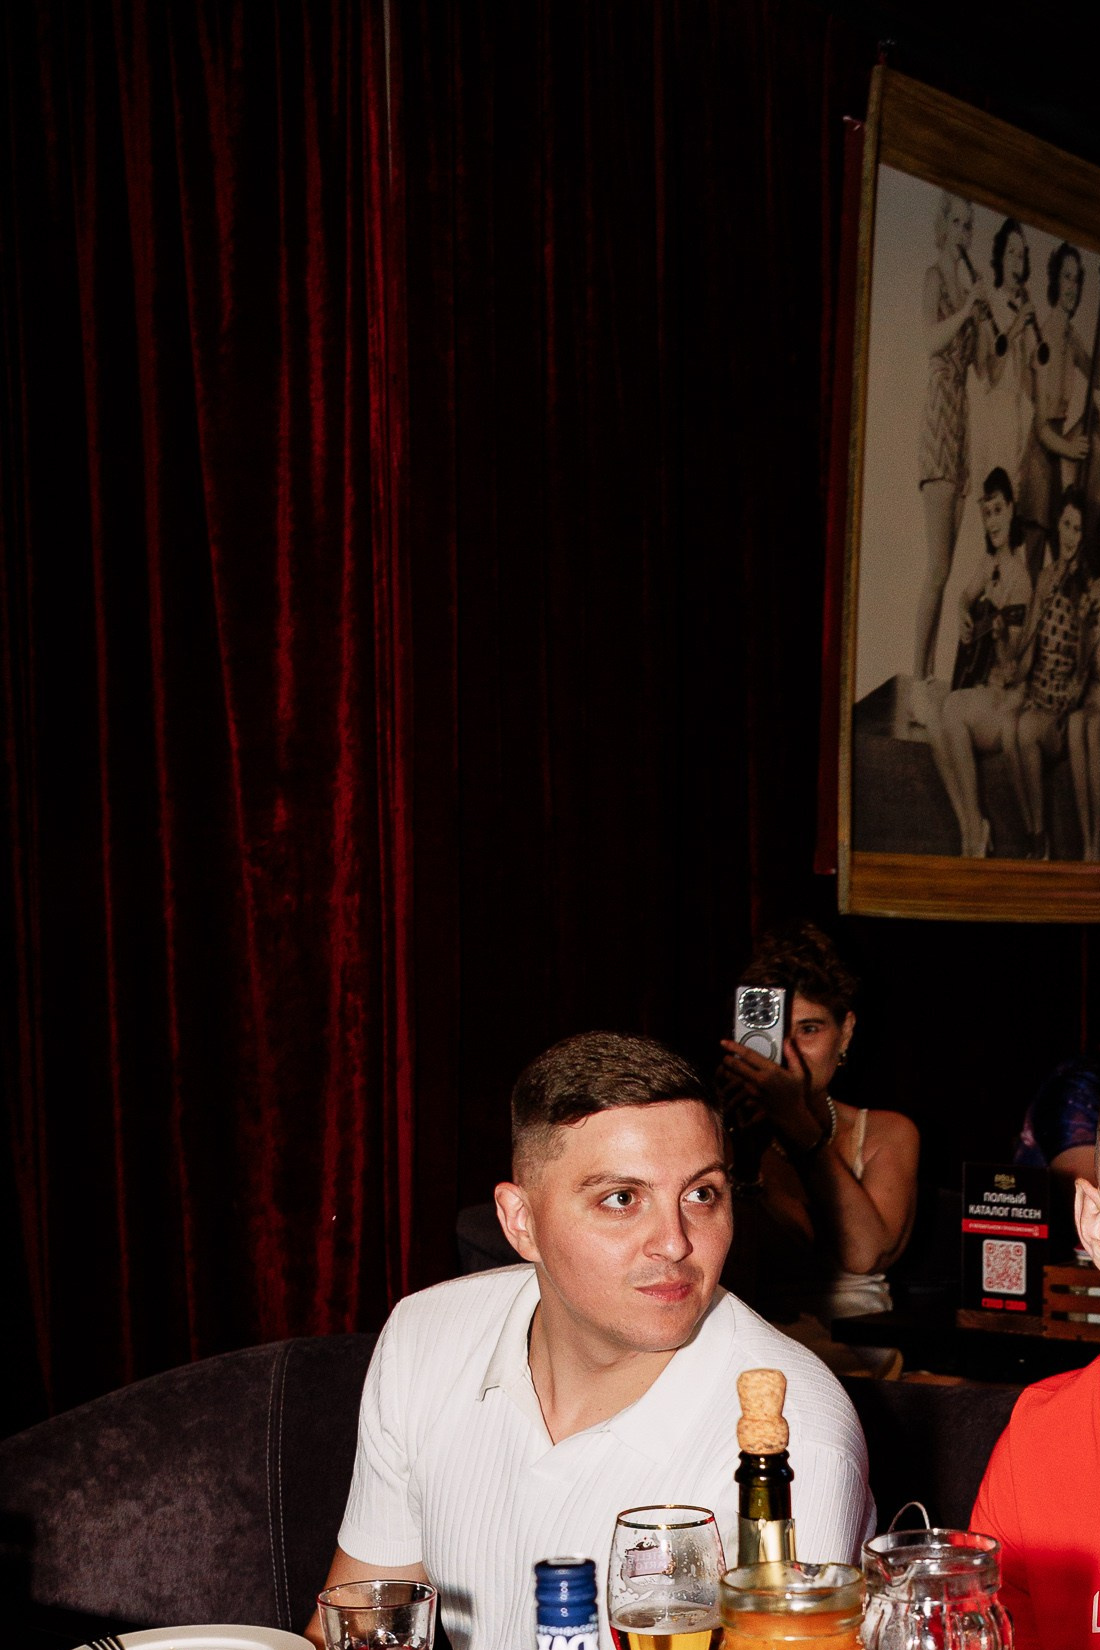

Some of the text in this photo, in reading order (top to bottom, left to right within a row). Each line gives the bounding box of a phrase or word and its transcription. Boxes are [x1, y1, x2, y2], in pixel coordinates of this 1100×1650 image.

[983, 1192, 1026, 1204] ПОЛНЫЙ
[968, 1205, 1042, 1220] КАТАЛОГ ПЕСЕН
